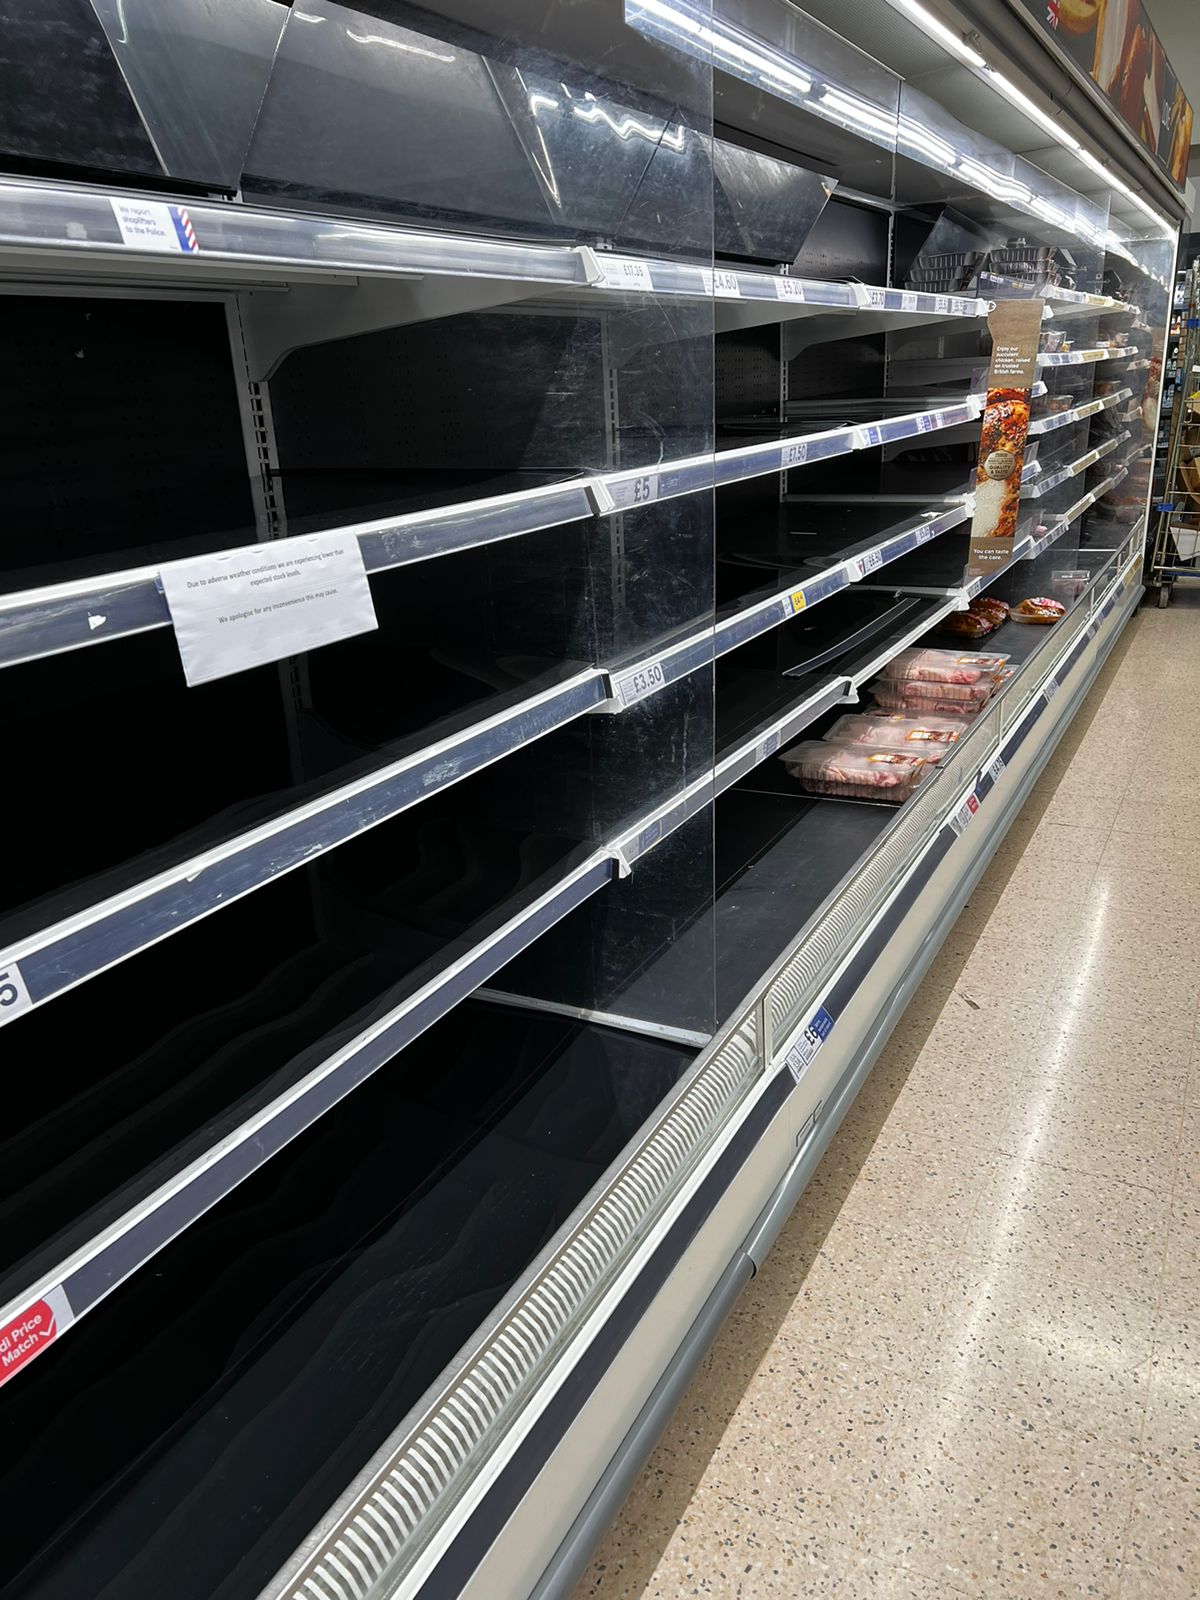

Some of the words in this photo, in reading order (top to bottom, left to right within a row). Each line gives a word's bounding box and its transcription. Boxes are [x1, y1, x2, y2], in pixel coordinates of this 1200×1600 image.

[122, 216, 157, 226] shoplifters
[130, 207, 152, 217] report
[134, 226, 145, 234] the
[634, 477, 650, 502] £5
[186, 581, 199, 589] Due
[208, 575, 228, 585] adverse
[229, 569, 251, 580] weather
[251, 563, 277, 575] conditions
[294, 554, 322, 565] experiencing
[250, 575, 273, 587] expected
[273, 572, 286, 581] stock
[218, 616, 228, 624] We
[229, 610, 254, 621] apologise
[254, 607, 262, 615] for
[262, 605, 272, 613] any
[272, 597, 305, 610] inconvenience
[305, 593, 314, 602] this
[314, 592, 325, 600] may
[633, 665, 662, 693] £3.50
[0, 971, 18, 1007] 5
[804, 1024, 819, 1046] £6
[10, 1314, 42, 1343] Price
[1, 1333, 39, 1367] Match
